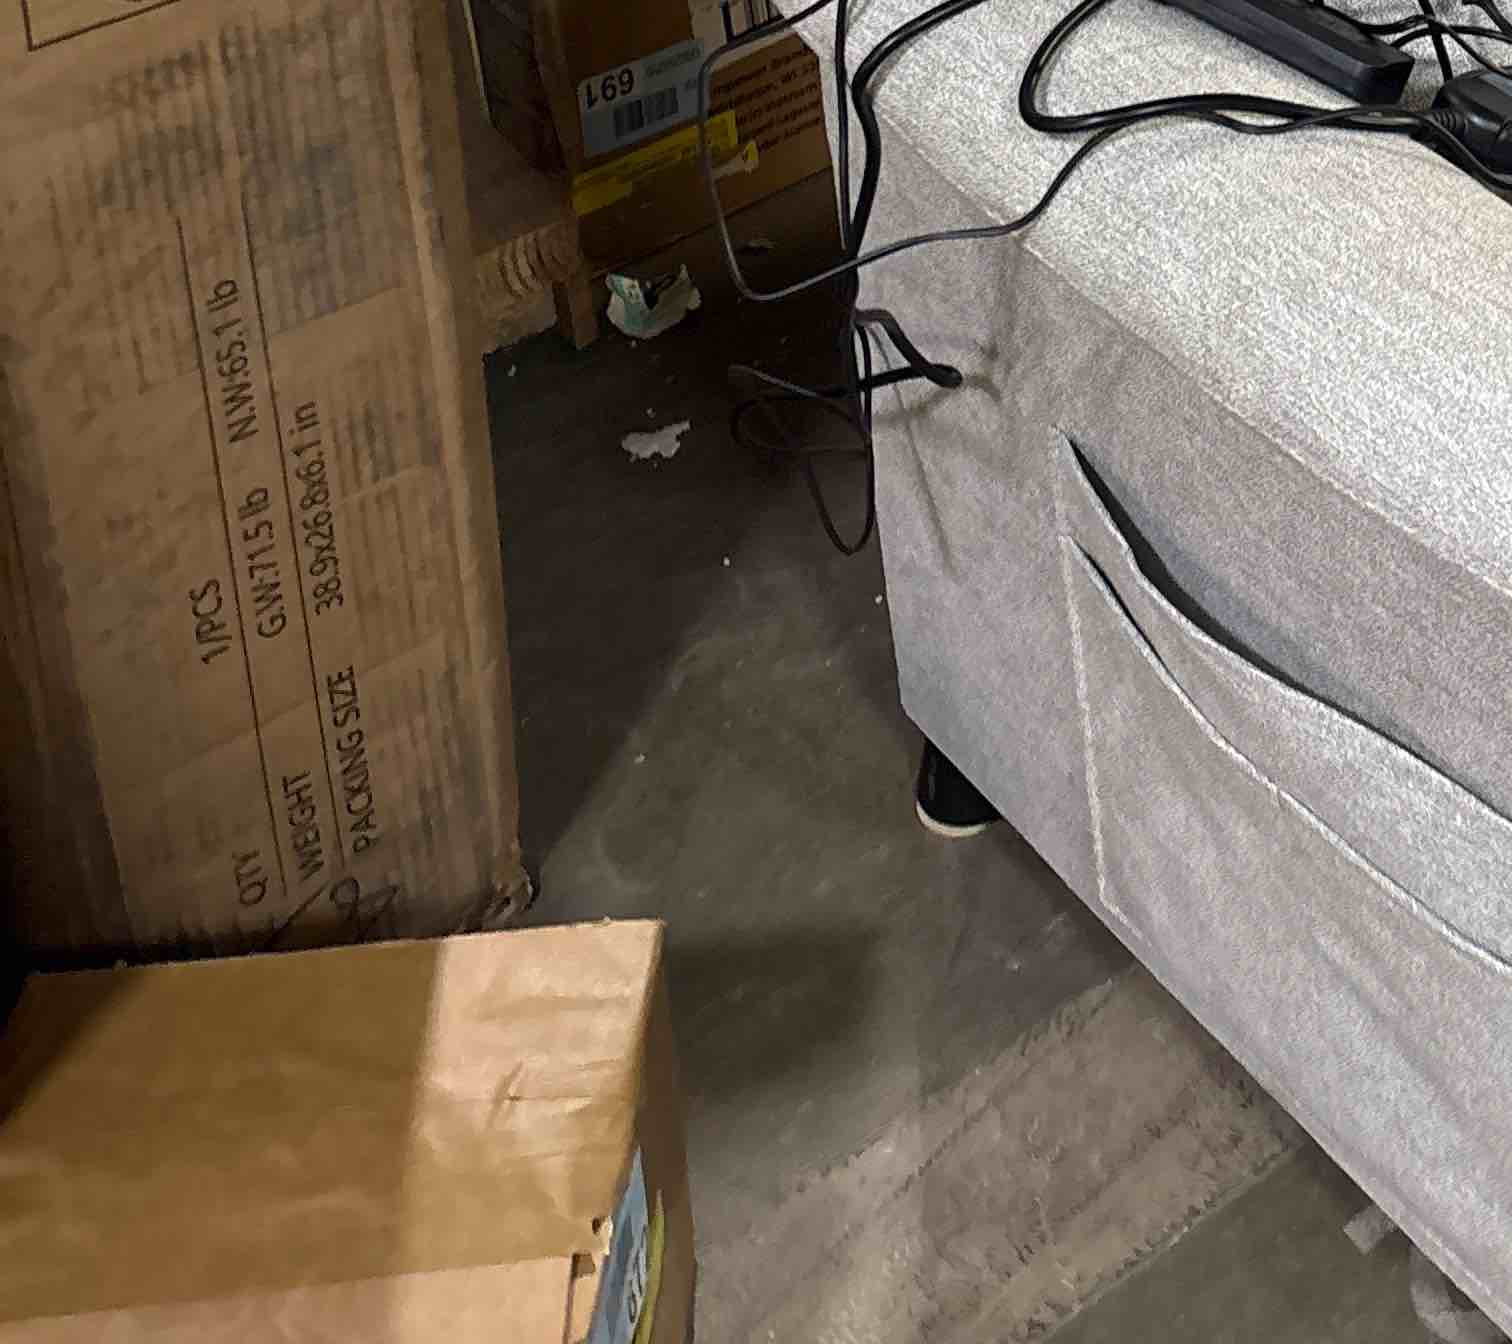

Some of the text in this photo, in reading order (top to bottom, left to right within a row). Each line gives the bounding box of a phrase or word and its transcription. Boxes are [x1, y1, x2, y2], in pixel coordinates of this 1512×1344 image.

[206, 278, 240, 314] lb
[289, 399, 321, 436] in
[236, 486, 271, 522] lb
[194, 578, 233, 664] 1/PCS
[328, 665, 358, 726] SIZE
[336, 731, 375, 853] PACKING
[283, 773, 325, 879] WEIGHT
[236, 850, 268, 907] QTY
